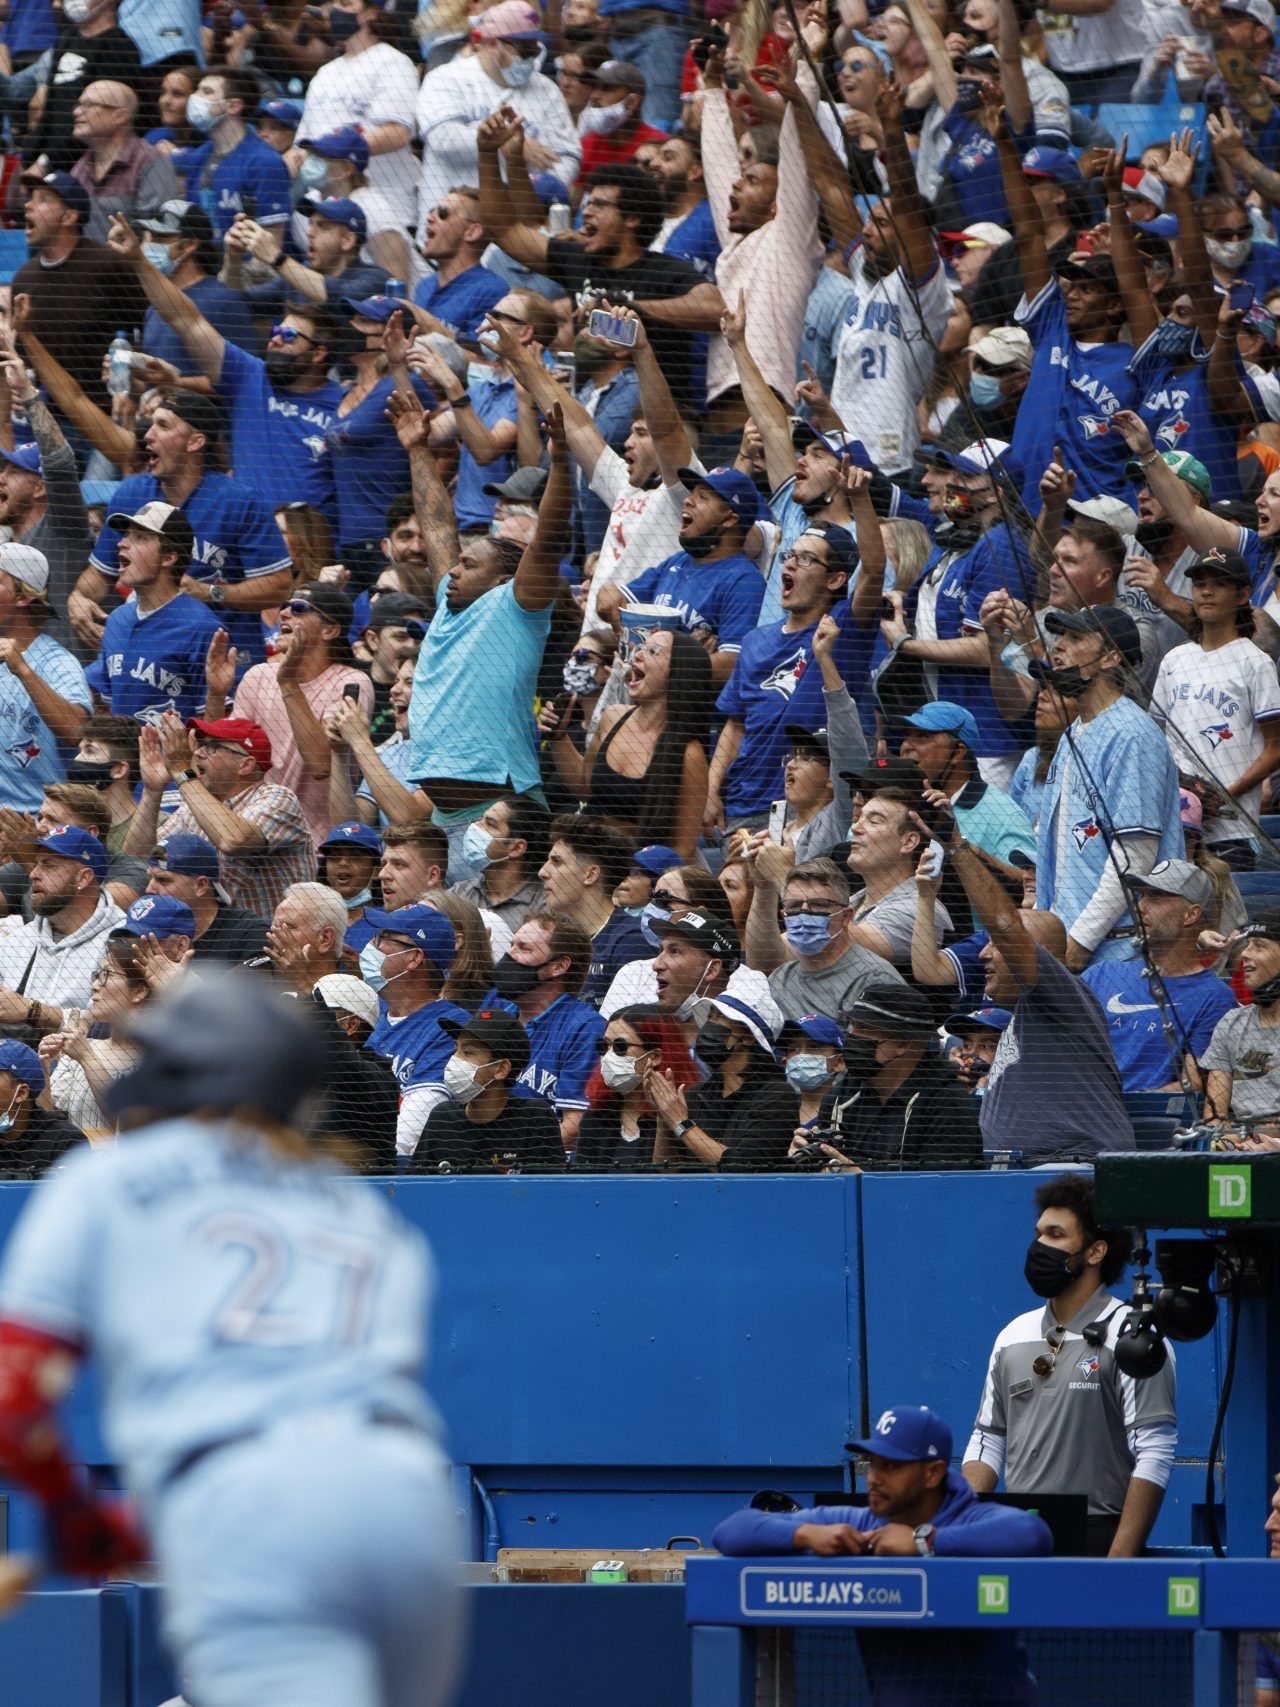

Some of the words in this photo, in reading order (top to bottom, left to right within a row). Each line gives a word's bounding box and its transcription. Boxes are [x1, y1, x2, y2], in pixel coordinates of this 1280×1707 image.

[859, 346, 887, 379] 21
[1071, 373, 1120, 417] JAYS
[130, 656, 185, 697] JAYS
[1194, 684, 1239, 717] JAYS
[1111, 1017, 1157, 1033] AIR
[1214, 1175, 1246, 1206] TD
[200, 1216, 374, 1348] 27
[875, 1410, 897, 1435] KC
[765, 1581, 901, 1606] BLUEJAYS.COM
[981, 1583, 1005, 1607] TD
[1171, 1584, 1196, 1609] TD
